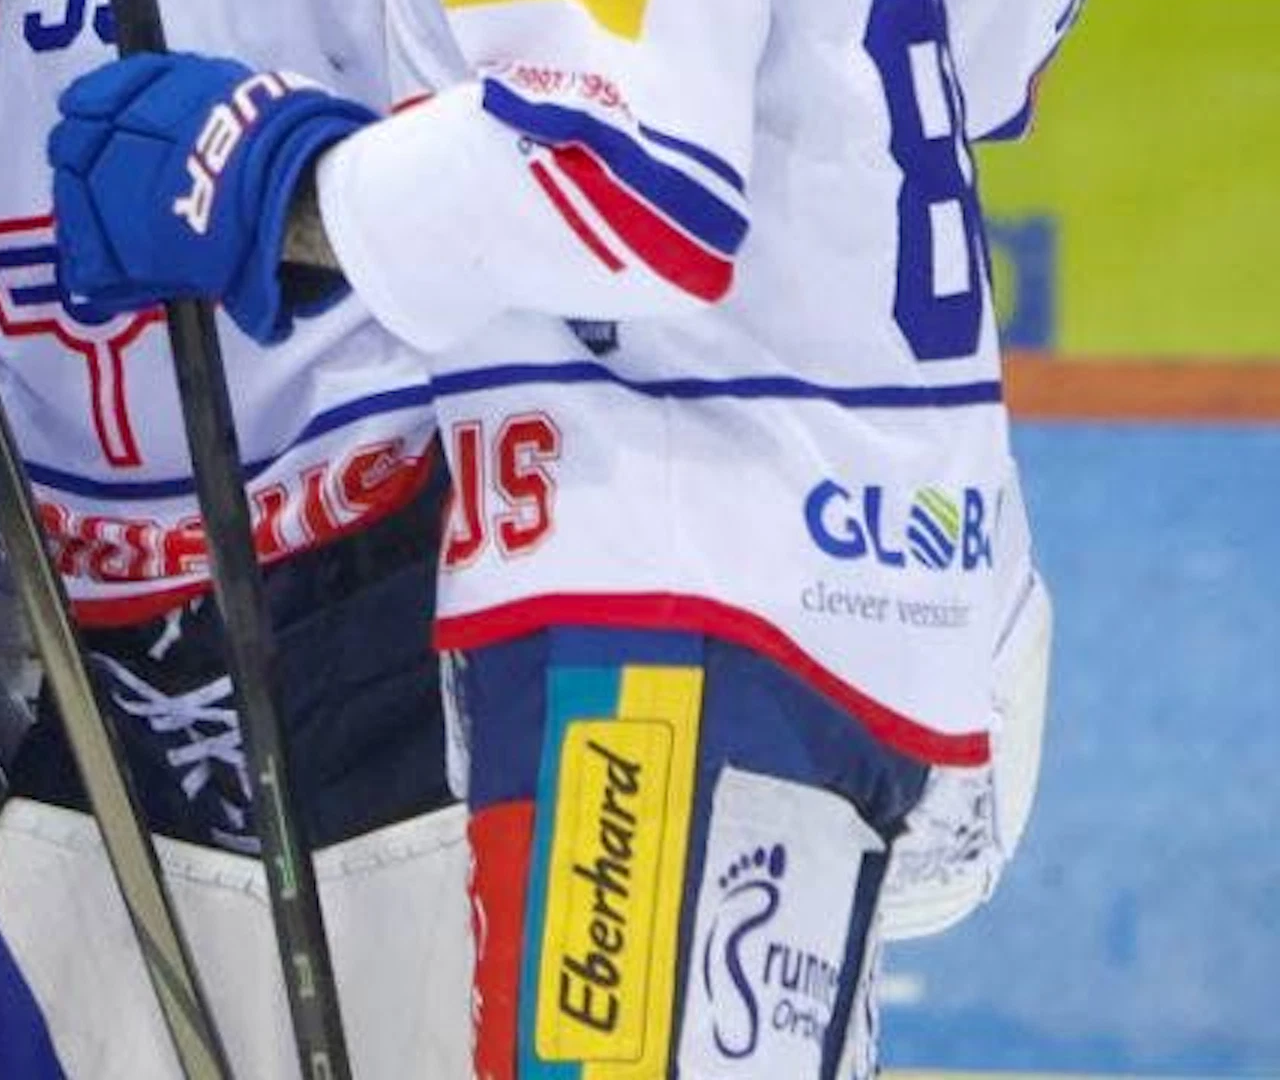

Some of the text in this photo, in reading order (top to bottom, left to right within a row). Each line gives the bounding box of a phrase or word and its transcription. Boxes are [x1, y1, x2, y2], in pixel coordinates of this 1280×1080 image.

[803, 477, 995, 574] GLOB
[801, 580, 891, 624] clever
[559, 740, 642, 1035] Eberhard
